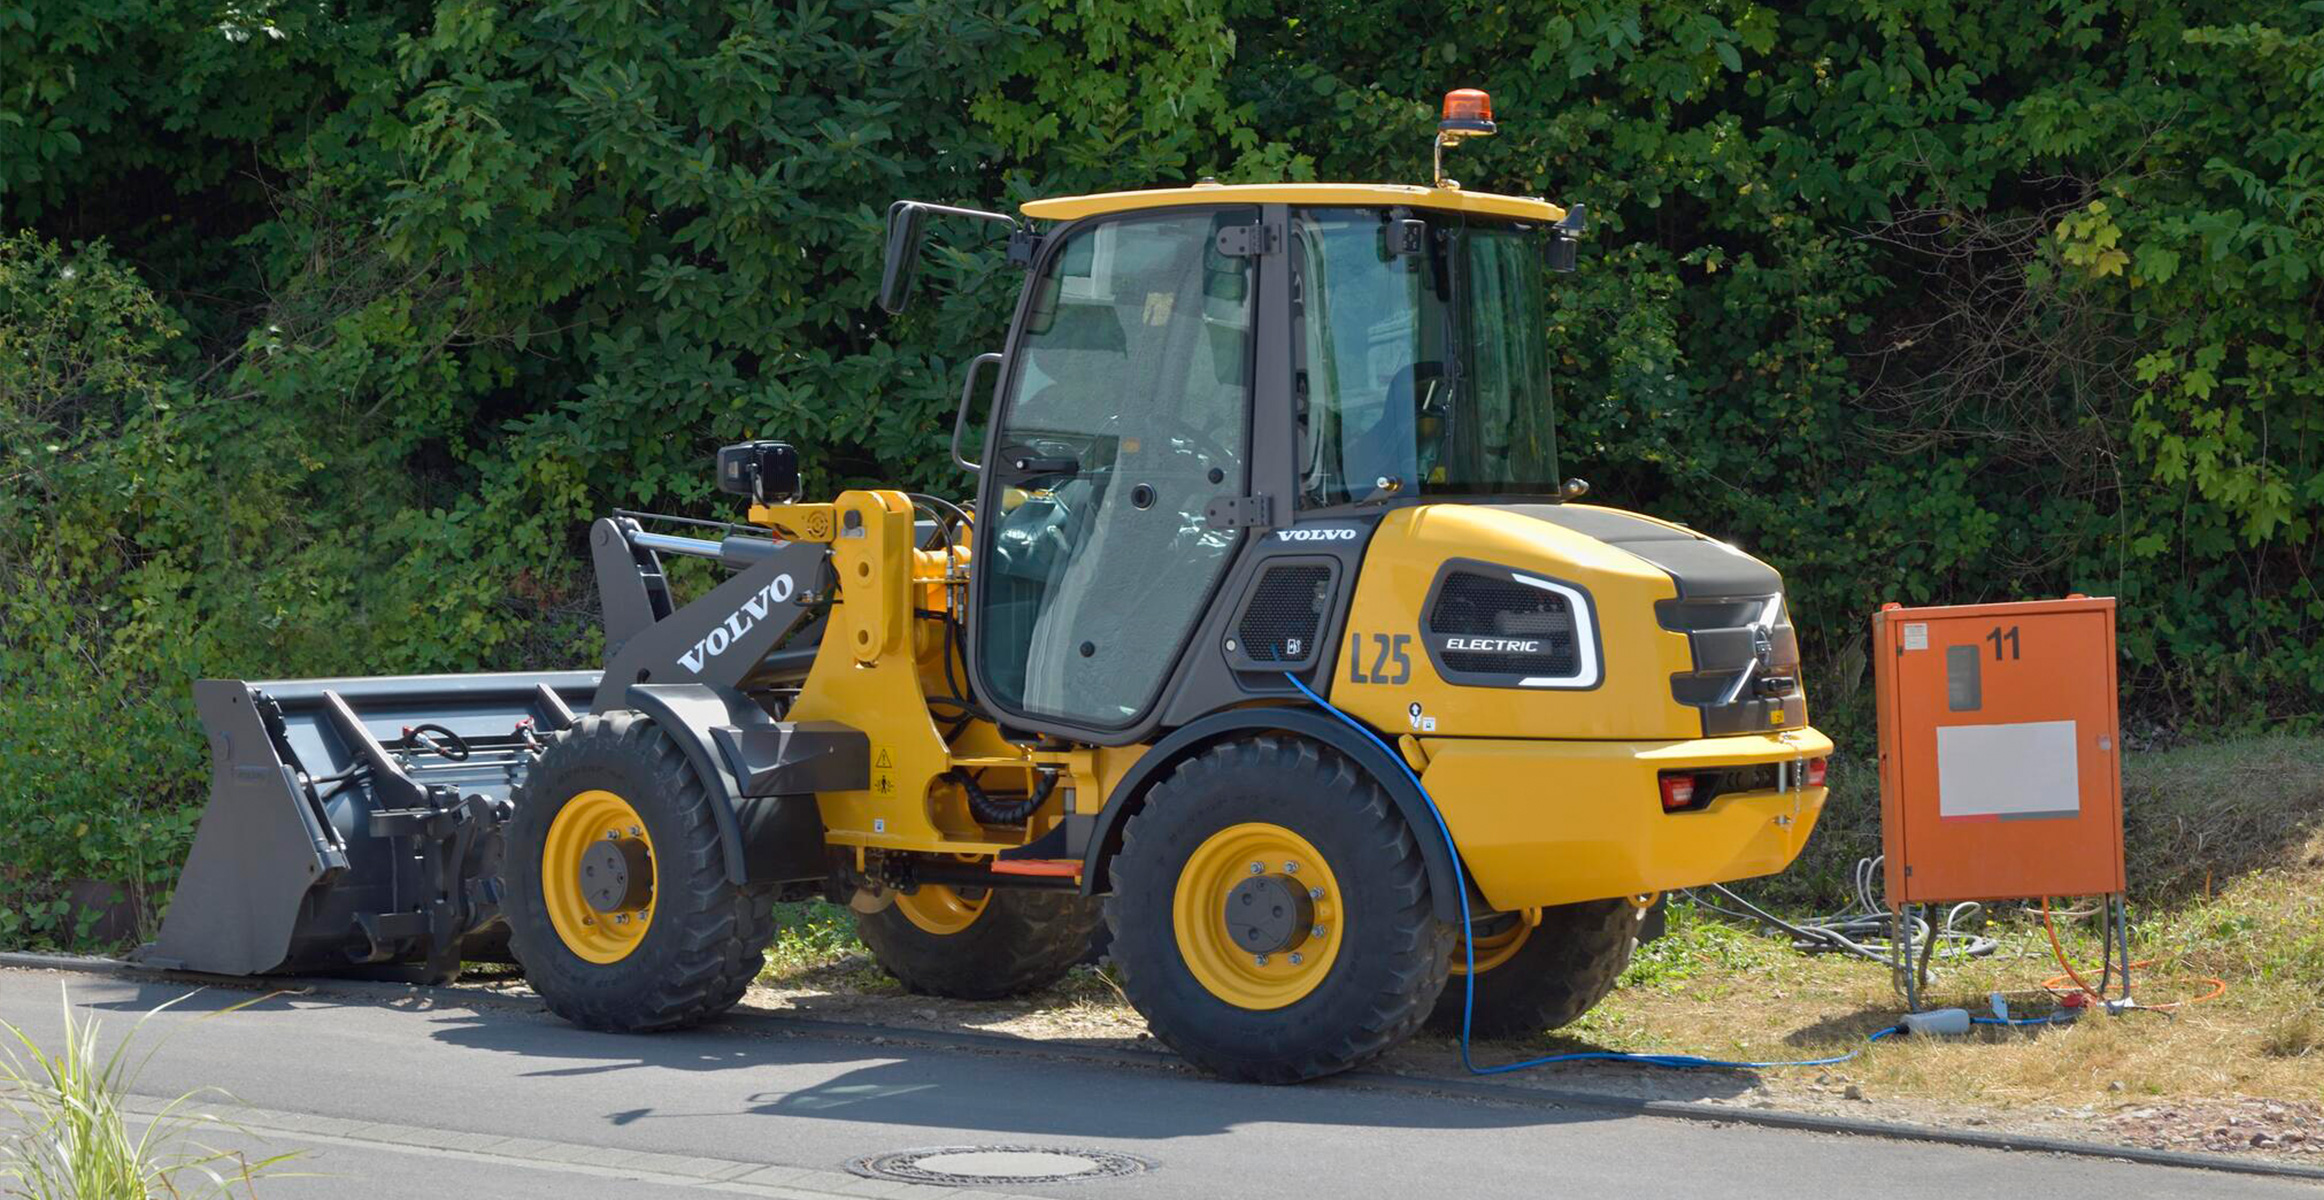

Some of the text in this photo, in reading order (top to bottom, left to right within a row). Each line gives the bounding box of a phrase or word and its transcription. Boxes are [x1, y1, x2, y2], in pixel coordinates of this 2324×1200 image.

[1276, 529, 1356, 541] VOLVO
[677, 573, 794, 674] VOLVO
[1351, 633, 1411, 685] L25
[1446, 638, 1539, 652] ELECTRIC
[1986, 626, 2020, 660] 11
